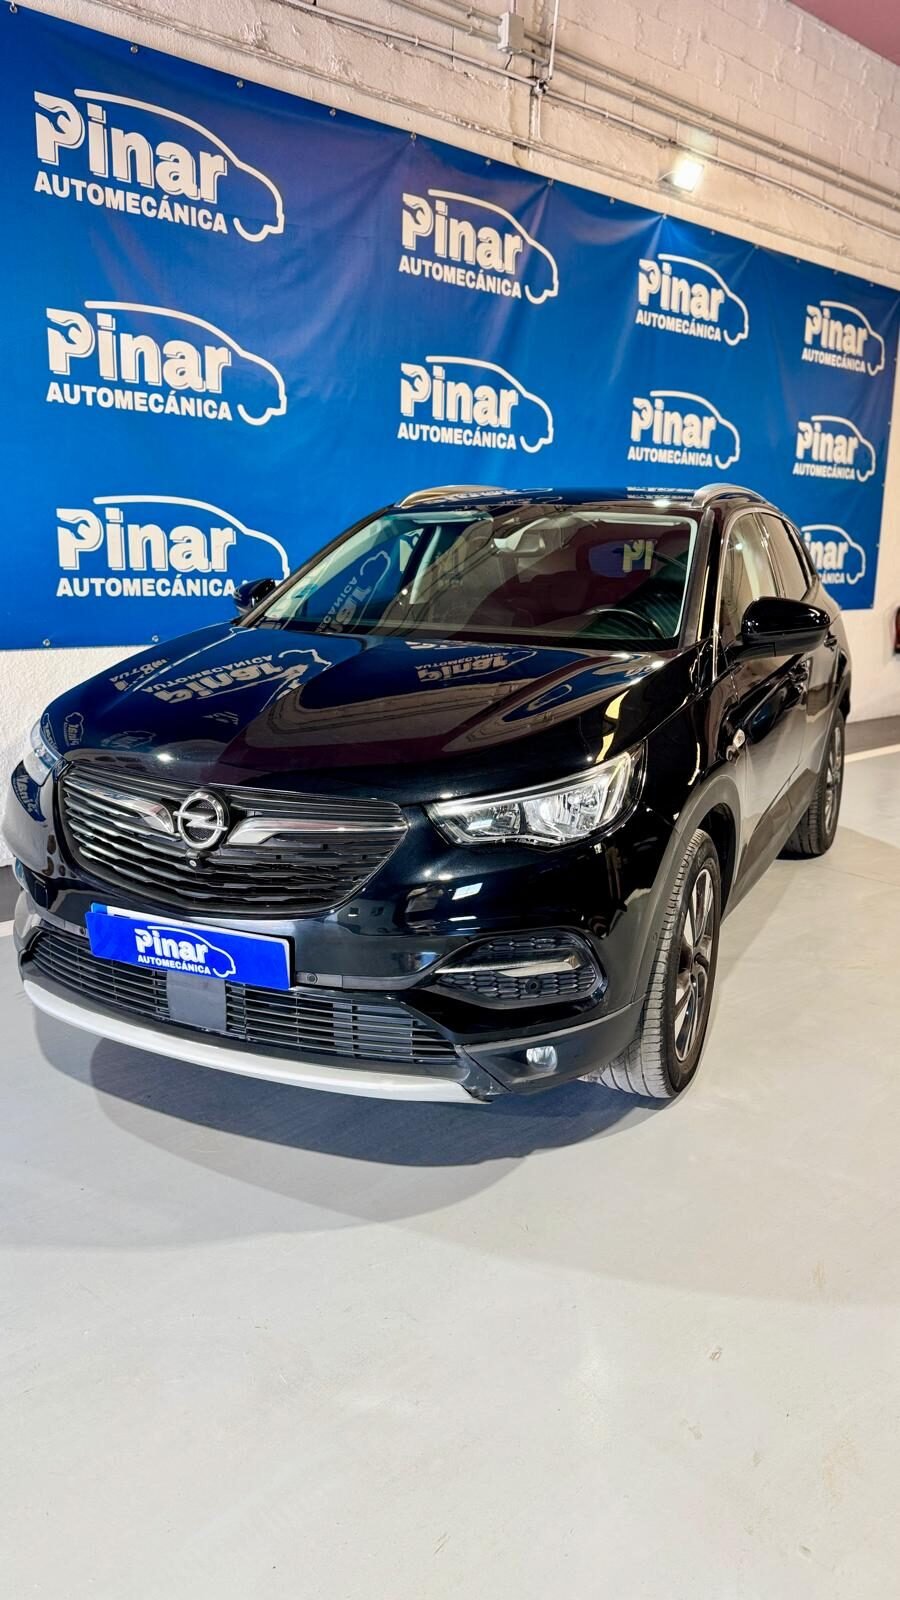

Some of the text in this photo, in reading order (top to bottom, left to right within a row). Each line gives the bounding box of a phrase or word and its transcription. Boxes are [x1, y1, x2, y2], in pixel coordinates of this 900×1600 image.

[34, 91, 227, 204] Pinar
[34, 171, 228, 234] AUTOMECÁNICA
[402, 191, 523, 275] Pinar
[399, 255, 522, 299] AUTOMECÁNICA
[638, 258, 725, 323] Pinar
[635, 309, 722, 342] AUTOMECÁNICA
[804, 305, 868, 357] Pinar
[46, 307, 231, 394] Pinar
[802, 347, 866, 374] AUTOMECÁNICA
[46, 382, 233, 421] AUTOMECÁNICA
[400, 362, 518, 428] Pinar
[398, 421, 517, 450] AUTOMECÁNICA
[631, 397, 717, 450] Pinar
[796, 421, 858, 465] Pinar
[628, 445, 713, 468] AUTOMECÁNICA
[793, 461, 856, 481] AUTOMECÁNICA
[56, 508, 236, 572] Pinar
[804, 532, 848, 569] inar
[56, 575, 236, 597] AUTOMECÁNICA
[134, 928, 208, 963] Pinar
[138, 955, 211, 975] AUTOMECÁNICA
